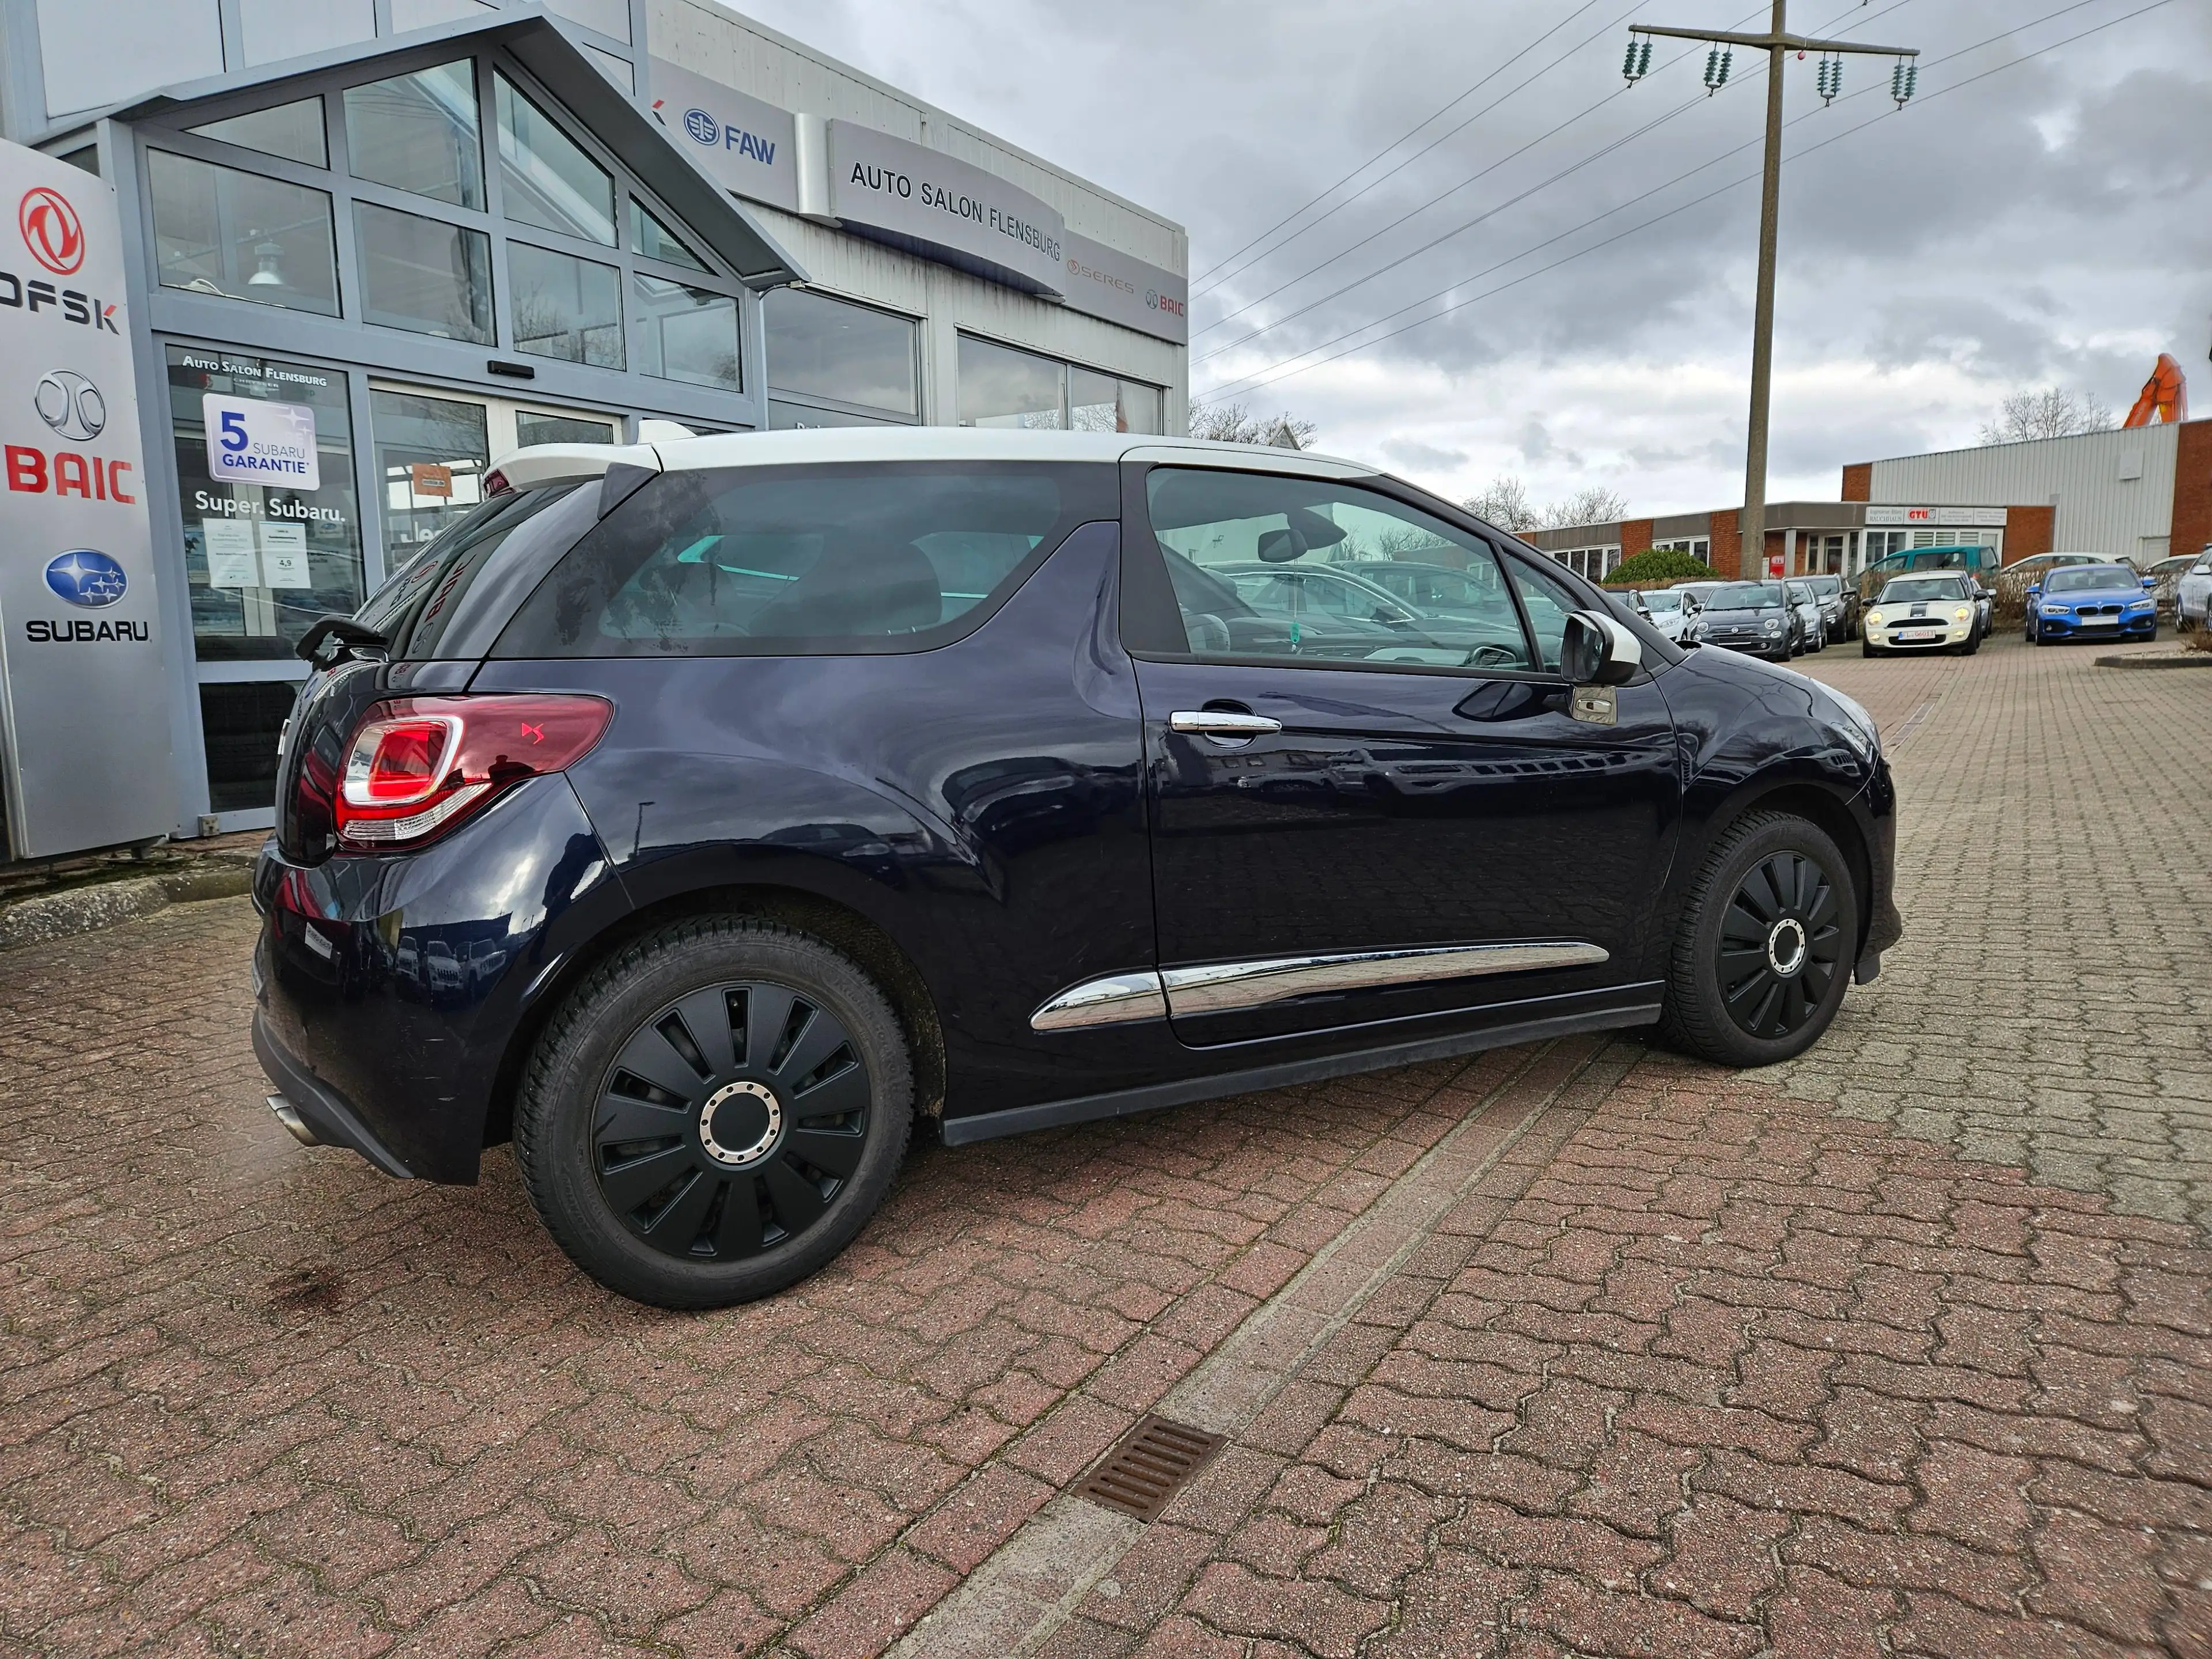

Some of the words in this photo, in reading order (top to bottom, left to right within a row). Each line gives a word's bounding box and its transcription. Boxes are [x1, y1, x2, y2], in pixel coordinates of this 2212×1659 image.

[725, 125, 775, 165] FAW
[850, 161, 912, 199] AUTO
[921, 181, 983, 224] SALON
[989, 206, 1061, 261] FLENSBURG
[1081, 266, 1134, 294] SERES
[0, 271, 120, 335] DFSK
[1160, 295, 1184, 317] BAIC
[220, 411, 248, 451] 5
[253, 442, 305, 459] SUBARU
[5, 445, 135, 504] BAIC
[195, 491, 264, 517] Super.
[269, 498, 346, 521] Subaru.
[1908, 509, 1929, 519] GTÜ
[26, 620, 148, 642] SUBARU
